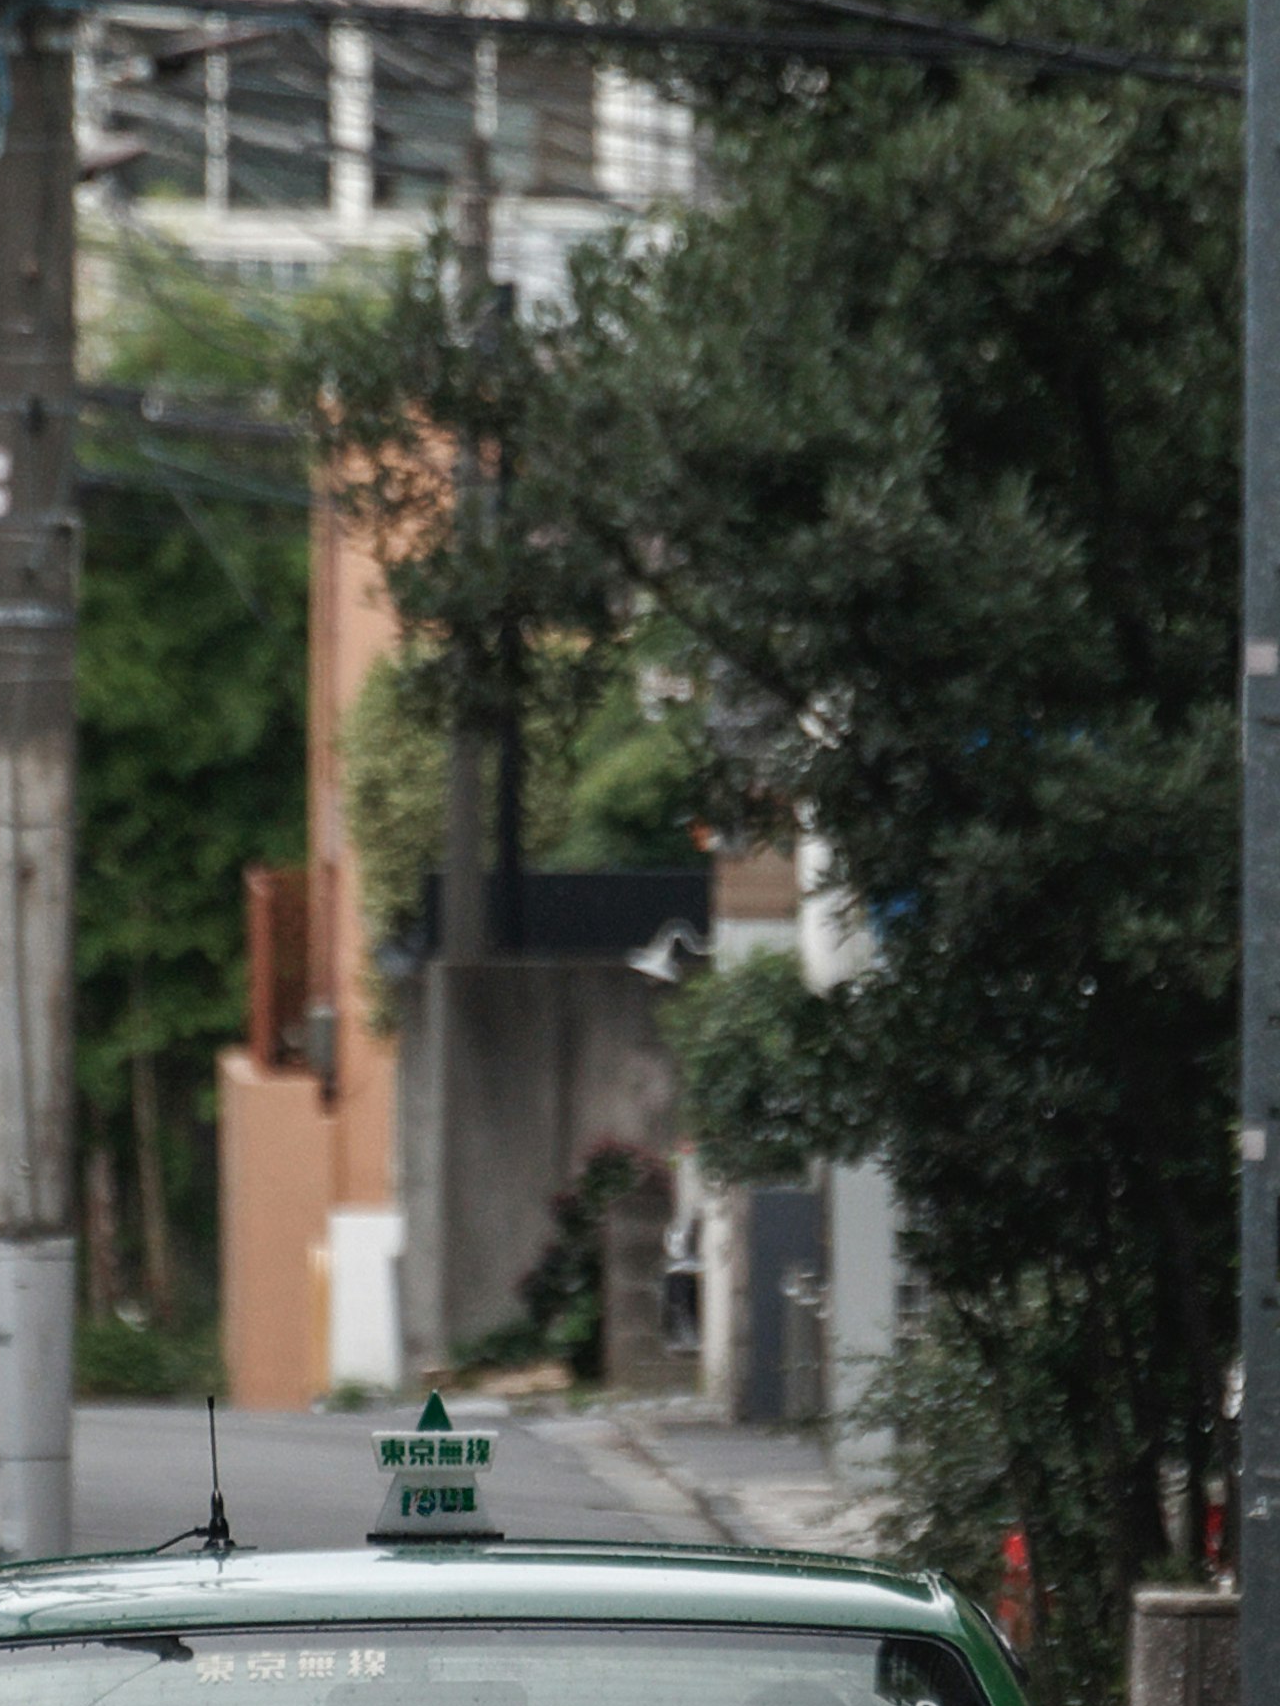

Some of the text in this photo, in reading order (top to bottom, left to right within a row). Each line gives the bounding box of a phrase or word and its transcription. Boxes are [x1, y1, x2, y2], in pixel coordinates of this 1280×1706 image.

[380, 1437, 491, 1467] 東京無線
[194, 1649, 386, 1684] 東京無線
